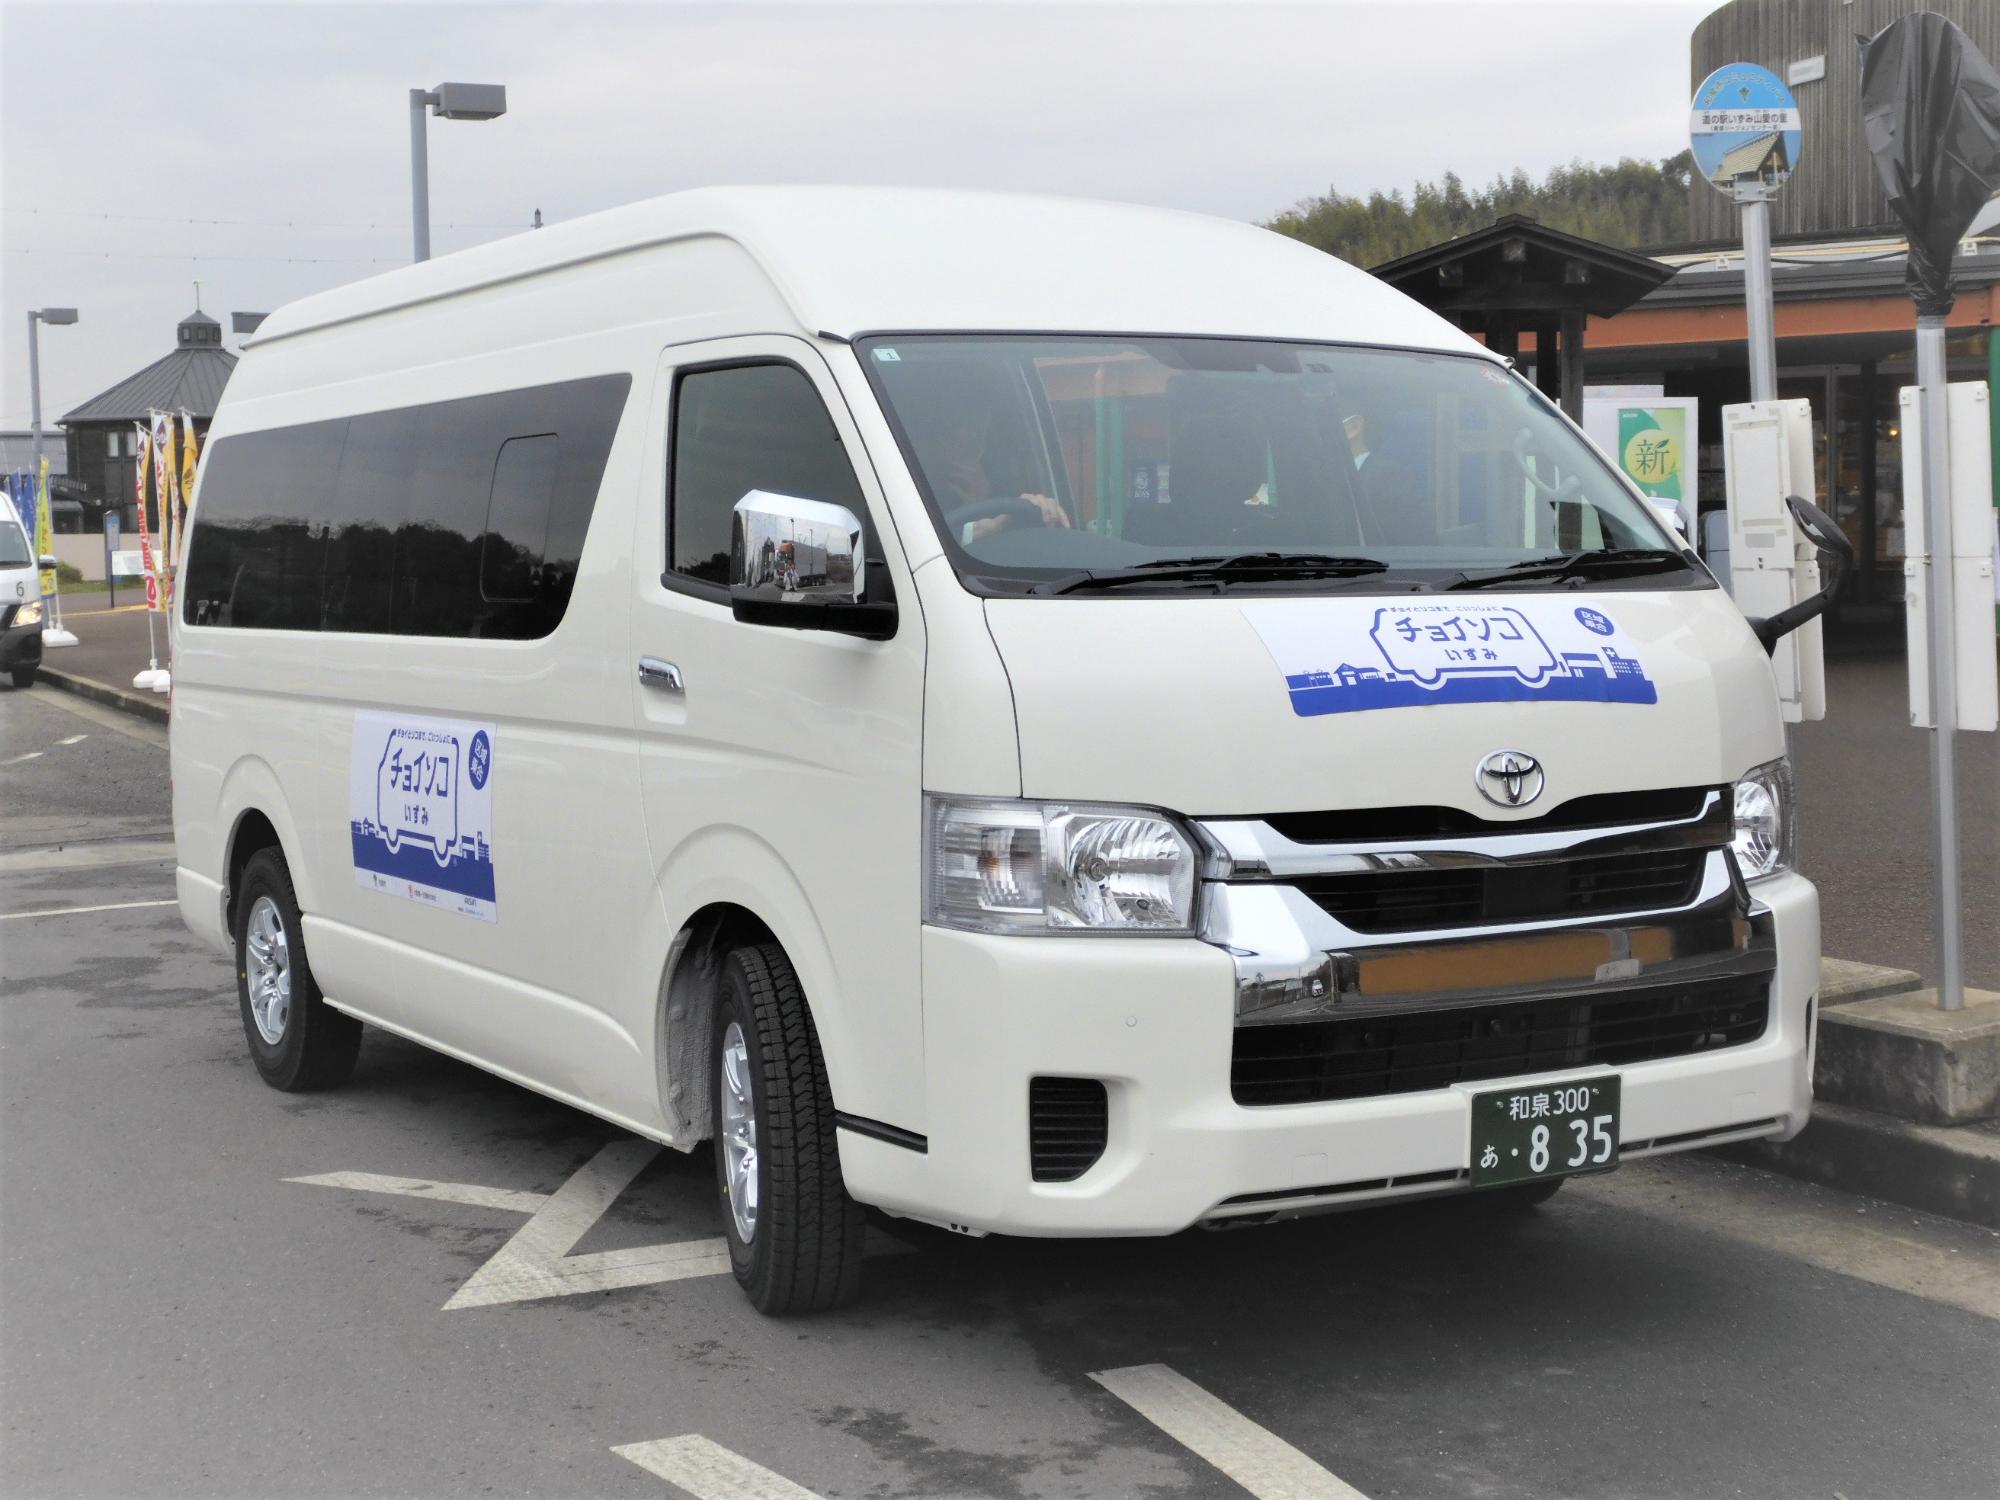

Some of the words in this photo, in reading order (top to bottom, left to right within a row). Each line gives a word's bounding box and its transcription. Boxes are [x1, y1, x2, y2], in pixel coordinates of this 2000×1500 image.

[1635, 438, 1671, 476] 新
[16, 581, 25, 597] 6
[1394, 616, 1524, 642] チョイソコ
[1443, 648, 1499, 661] いずみ
[391, 747, 449, 797] チョイソコ
[404, 803, 429, 826] いずみ
